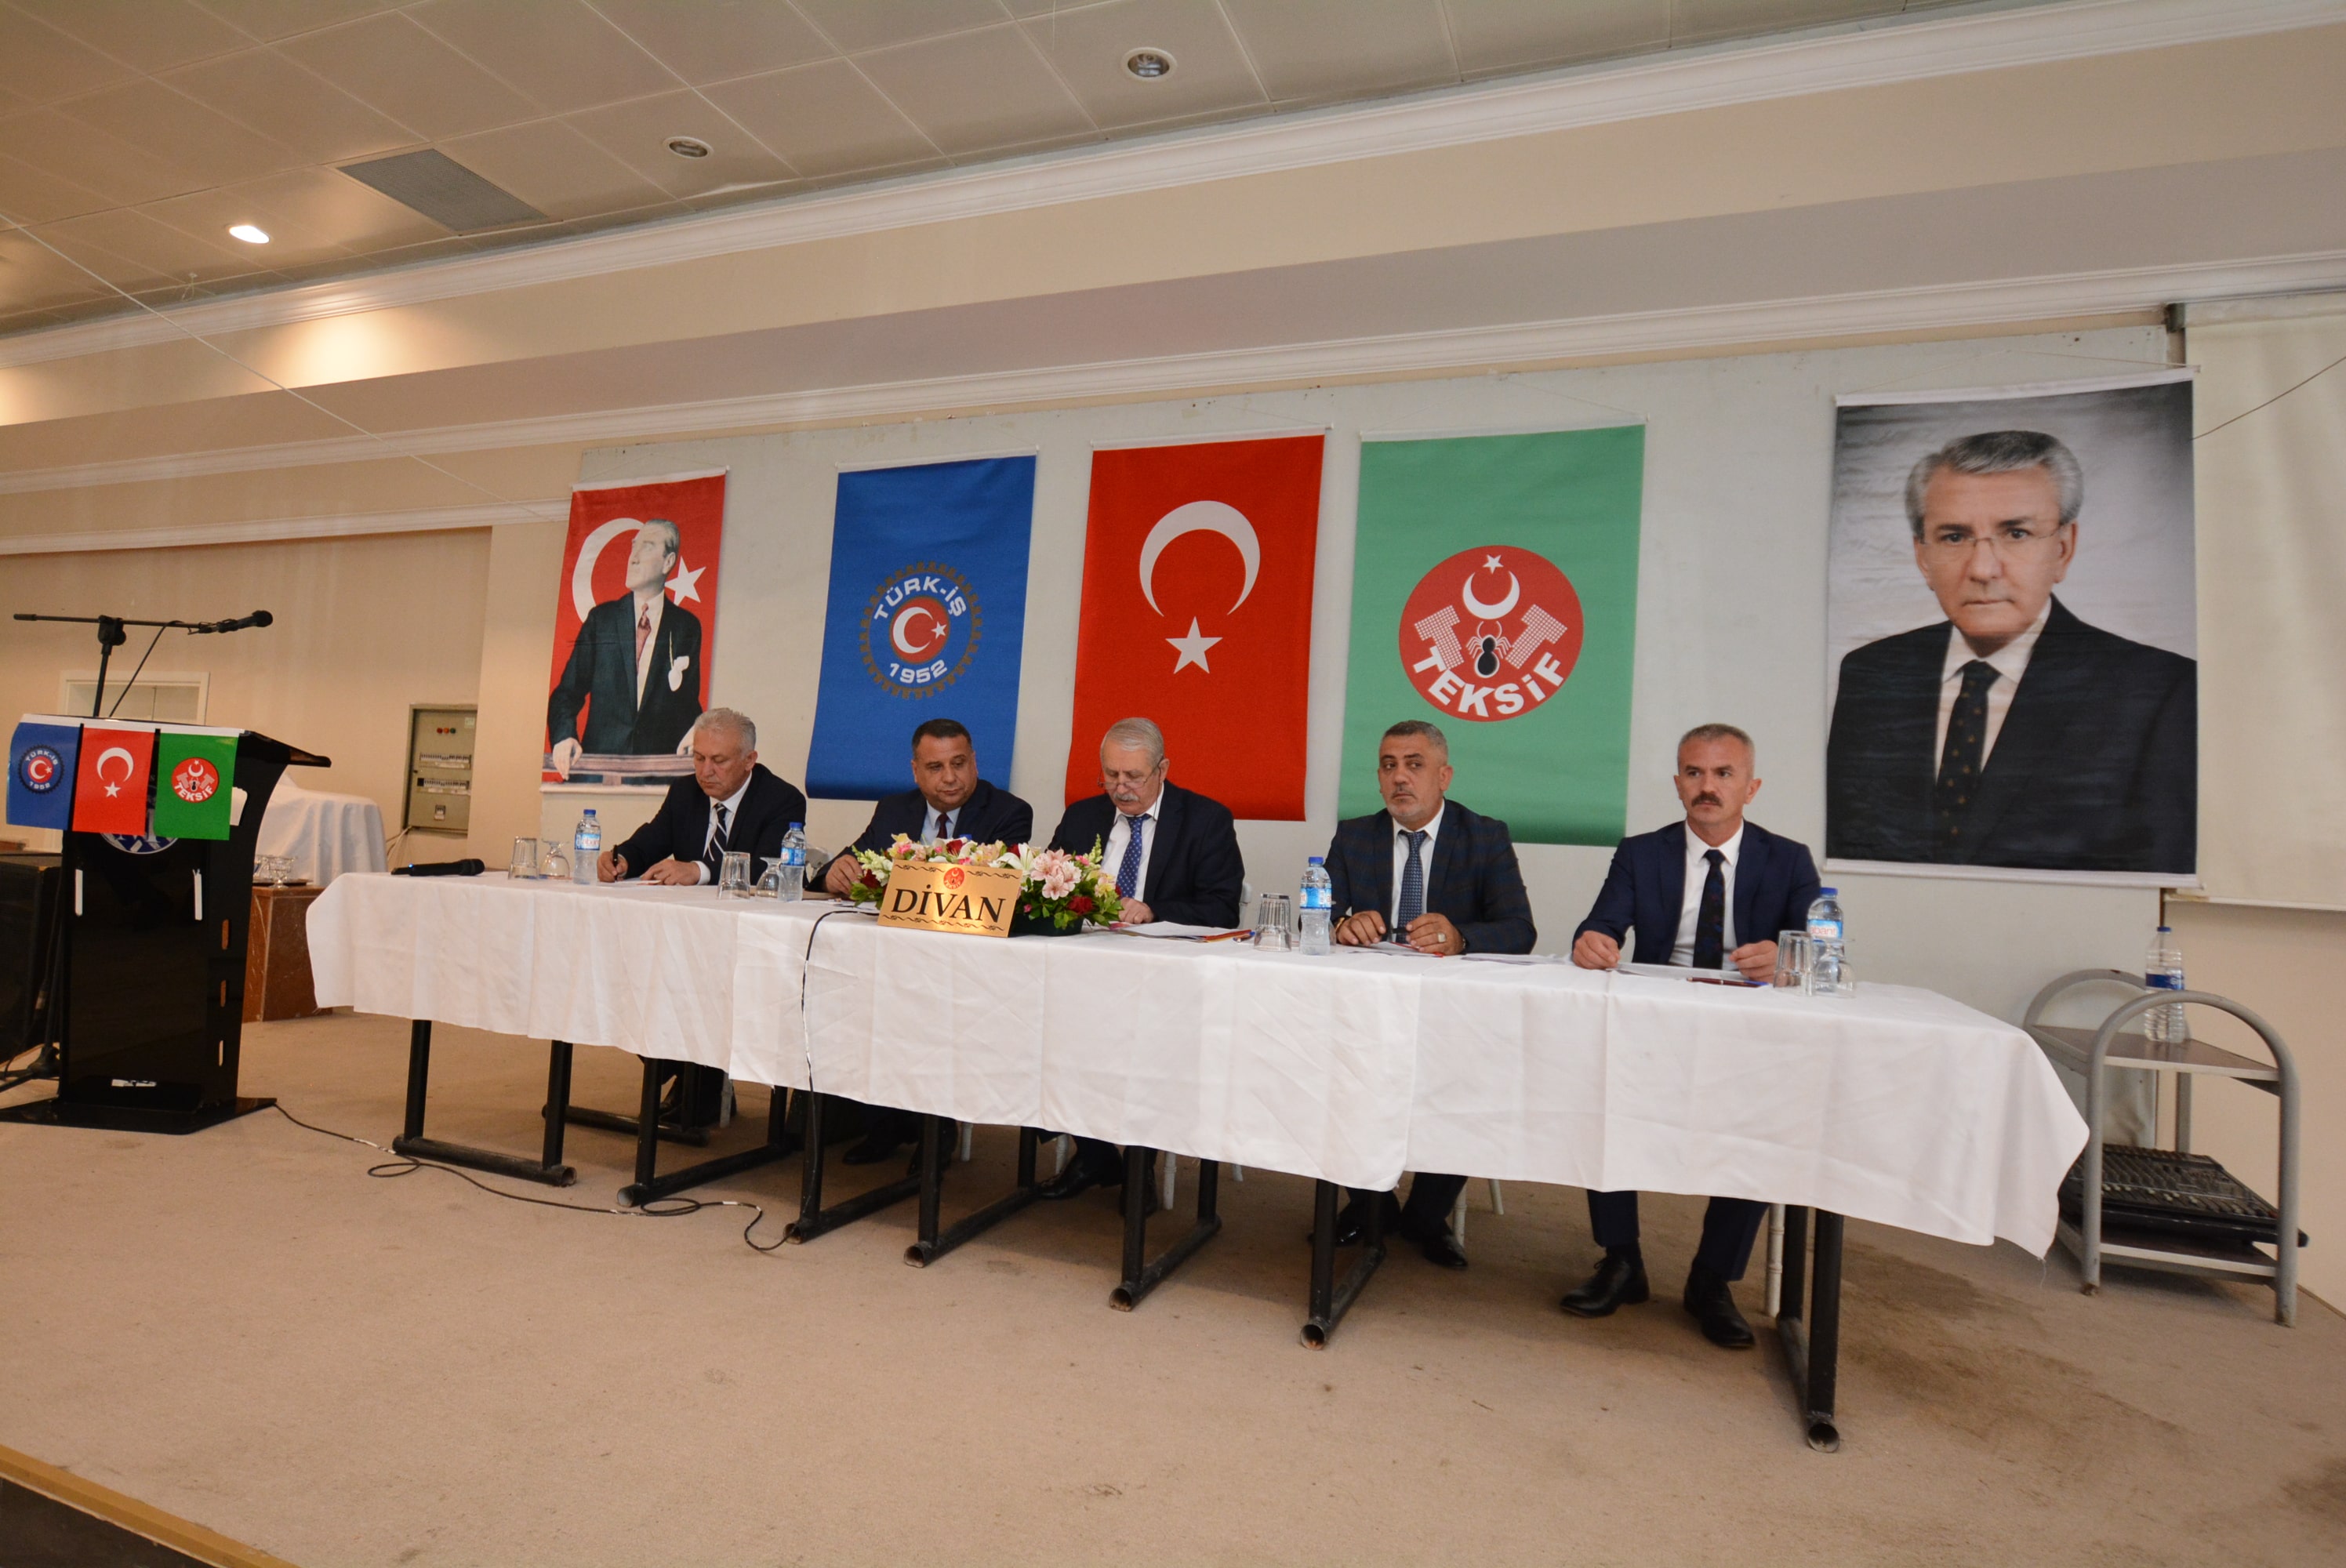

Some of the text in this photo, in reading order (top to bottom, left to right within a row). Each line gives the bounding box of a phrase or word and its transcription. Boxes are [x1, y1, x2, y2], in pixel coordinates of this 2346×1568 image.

[873, 575, 967, 617] TÜRK-İŞ
[889, 659, 948, 684] 1952
[1413, 645, 1564, 717] TEKSİF
[892, 884, 1006, 923] DİVAN
